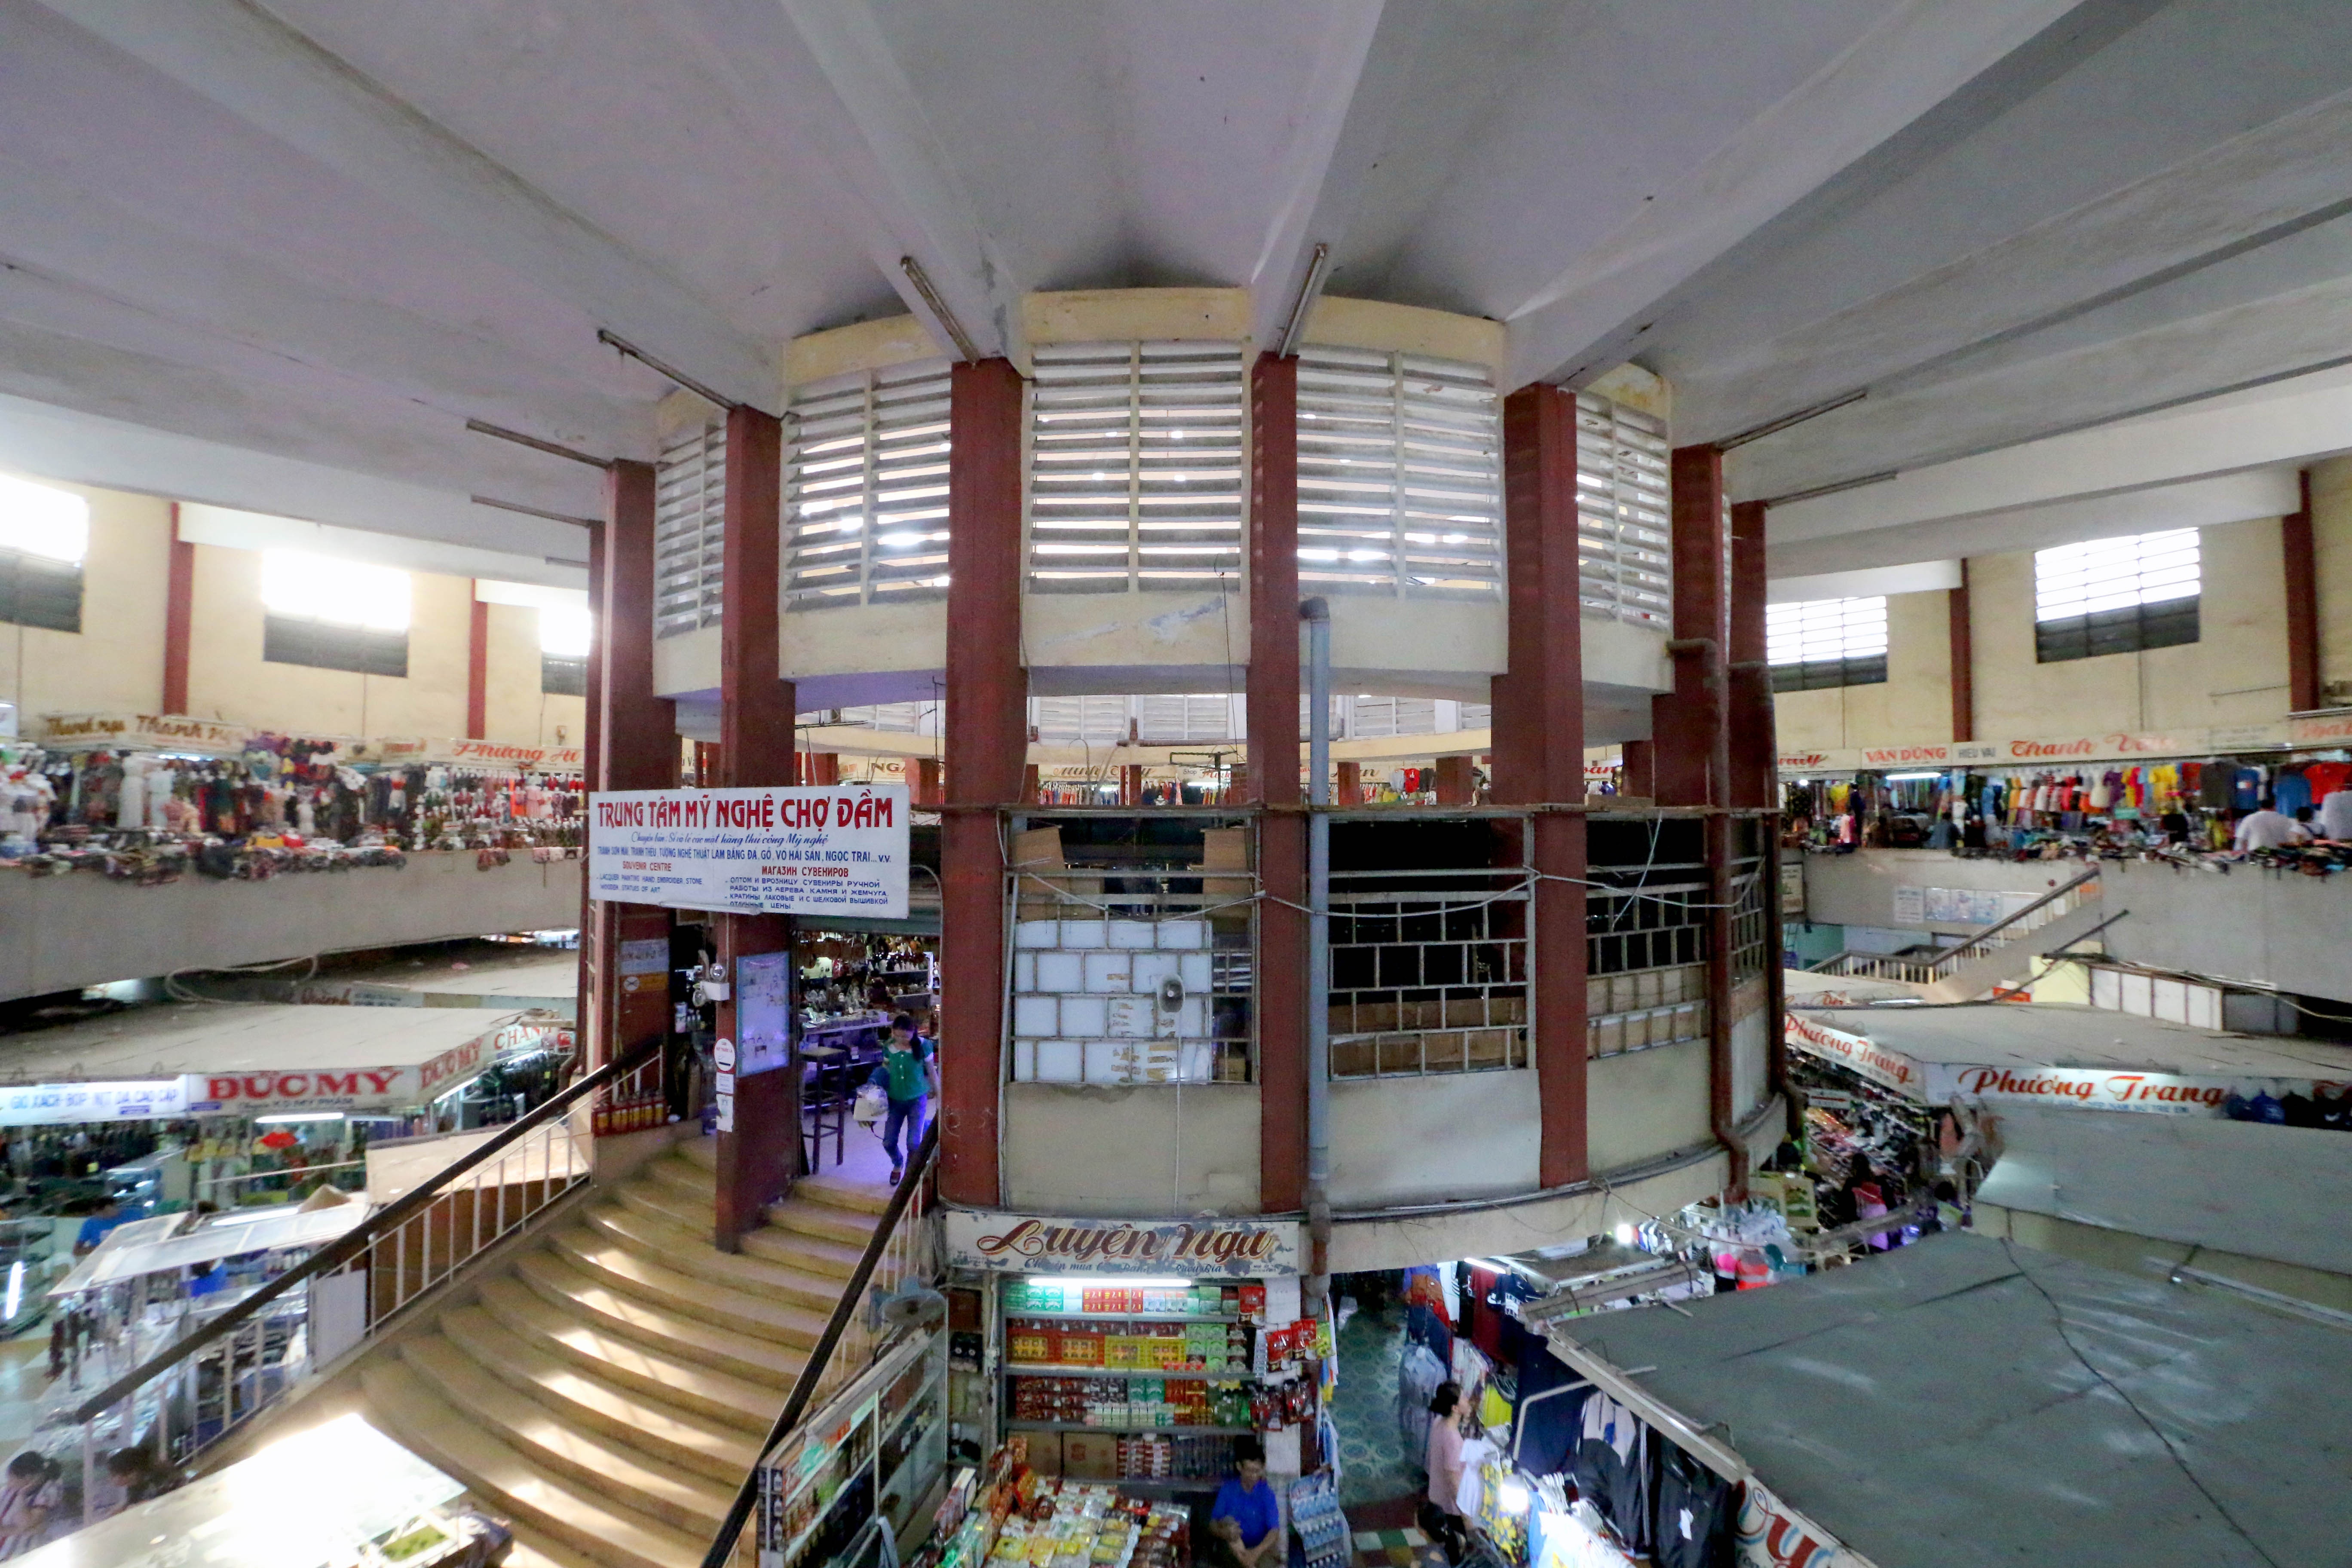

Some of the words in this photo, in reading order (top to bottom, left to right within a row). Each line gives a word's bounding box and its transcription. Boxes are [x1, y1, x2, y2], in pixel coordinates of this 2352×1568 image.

[2010, 738, 2094, 756] Thanh
[871, 763, 905, 773] NG
[598, 801, 643, 829] TRUNG
[648, 796, 680, 829] TÂM
[686, 794, 711, 830] MỸ
[716, 793, 774, 832] NGHỆ
[781, 796, 830, 832] CHỢ
[837, 789, 892, 830] ĐẦM
[721, 833, 742, 848] hàng
[803, 833, 829, 848] nghệ
[826, 851, 849, 863] NGỌC
[649, 862, 672, 872] CENTRE
[761, 866, 797, 876] МАГАЗИН
[802, 867, 849, 878] СУВЕНИРОВ
[847, 879, 880, 888] РУЧНОЙ
[1958, 1066, 2096, 1101] Phương
[2106, 1075, 2225, 1108] Trang
